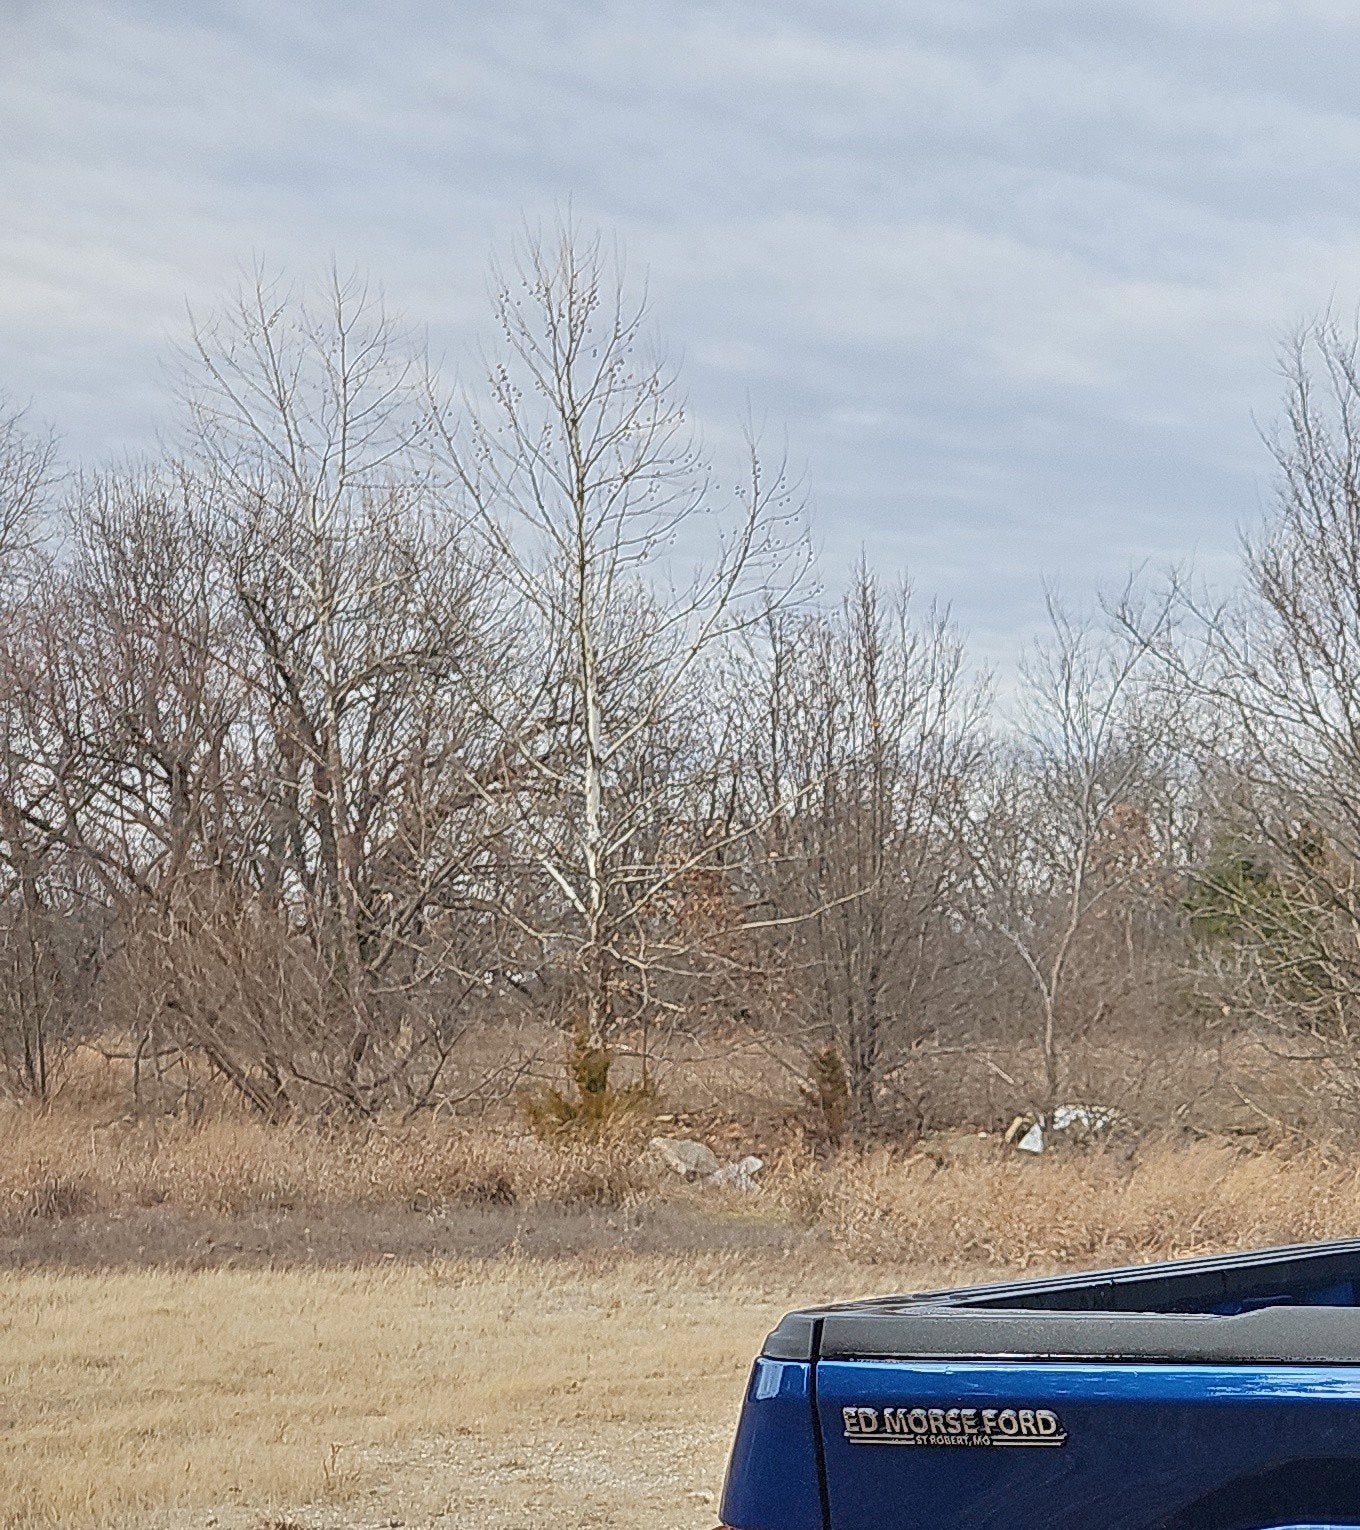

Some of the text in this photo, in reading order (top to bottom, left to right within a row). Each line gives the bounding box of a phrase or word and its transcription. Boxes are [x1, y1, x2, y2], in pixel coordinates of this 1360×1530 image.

[841, 1407, 1058, 1435] ED MORSE FORD
[973, 1436, 991, 1446] MO
